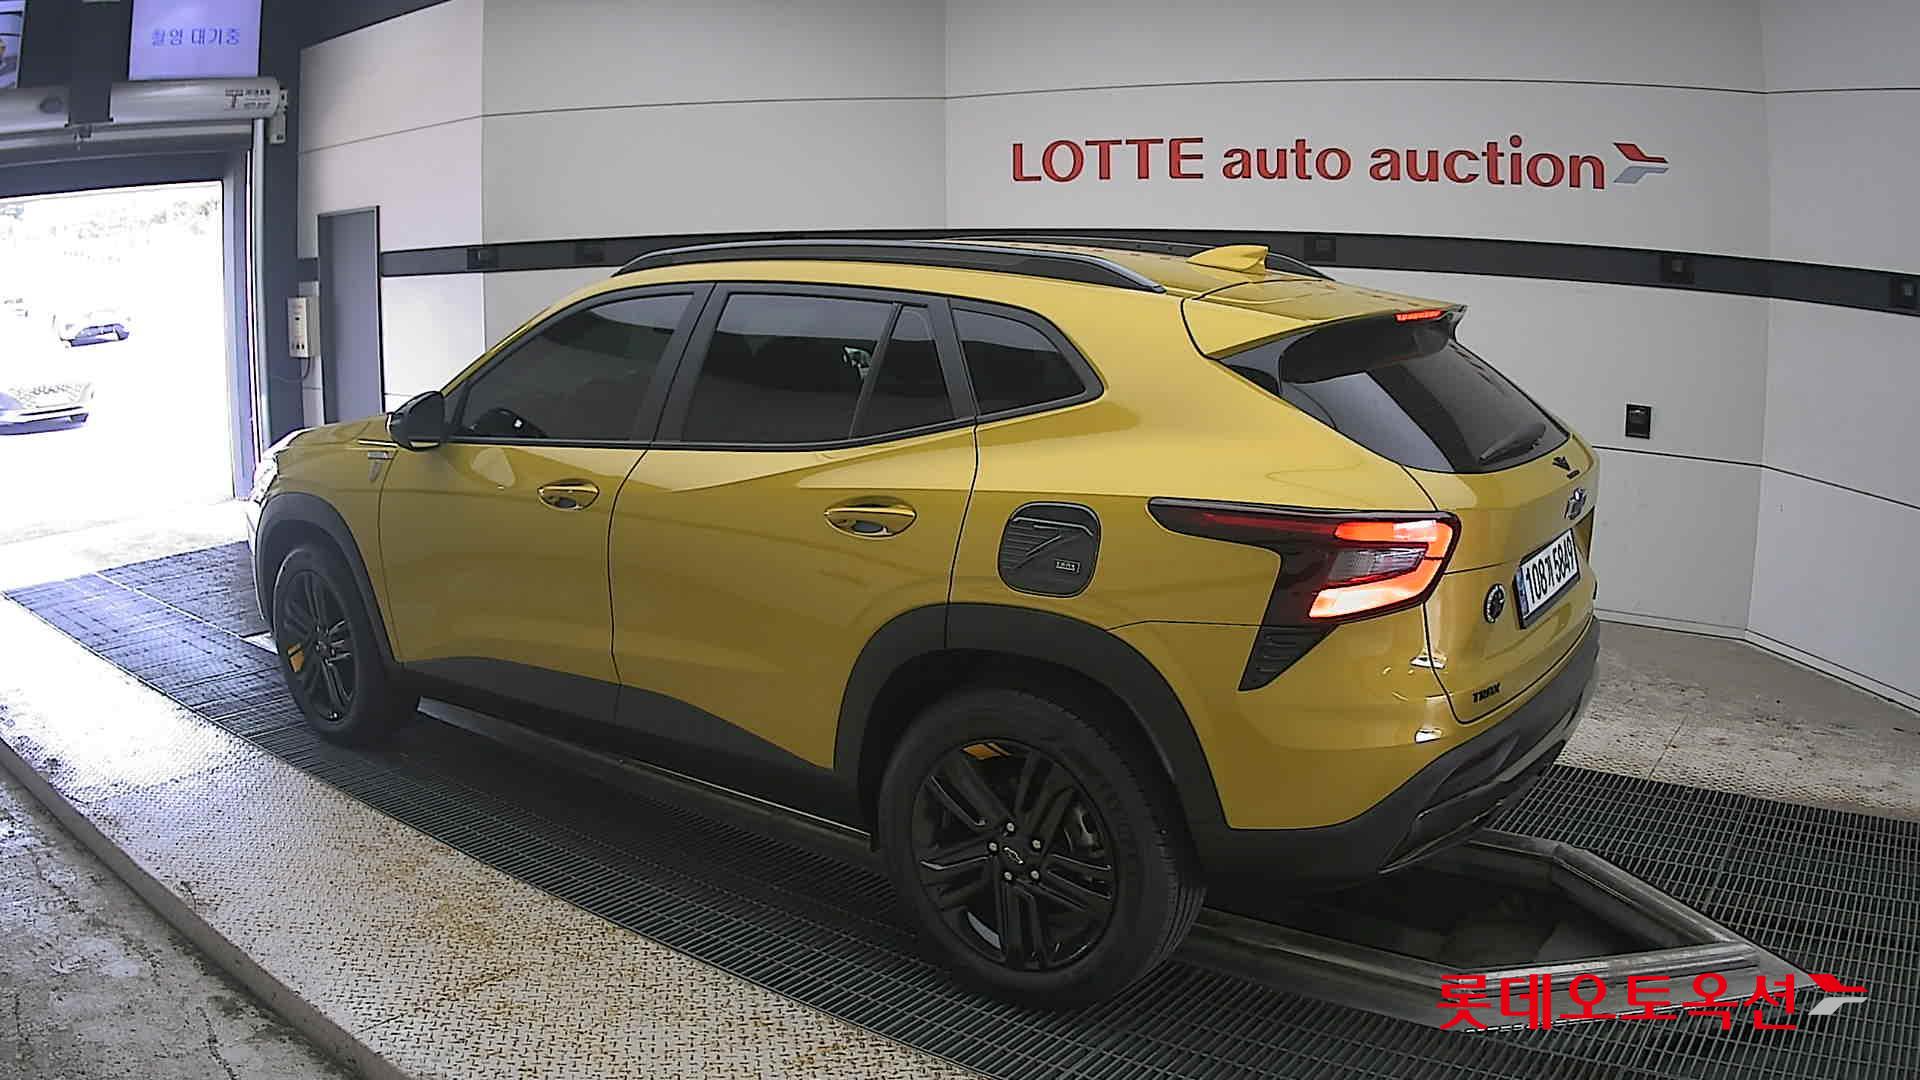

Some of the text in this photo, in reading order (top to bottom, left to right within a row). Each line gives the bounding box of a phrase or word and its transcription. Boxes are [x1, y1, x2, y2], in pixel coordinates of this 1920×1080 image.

[191, 27, 240, 45] 대기중
[1011, 133, 1606, 190] LOTTE auto auction
[1552, 535, 1575, 585] 5849
